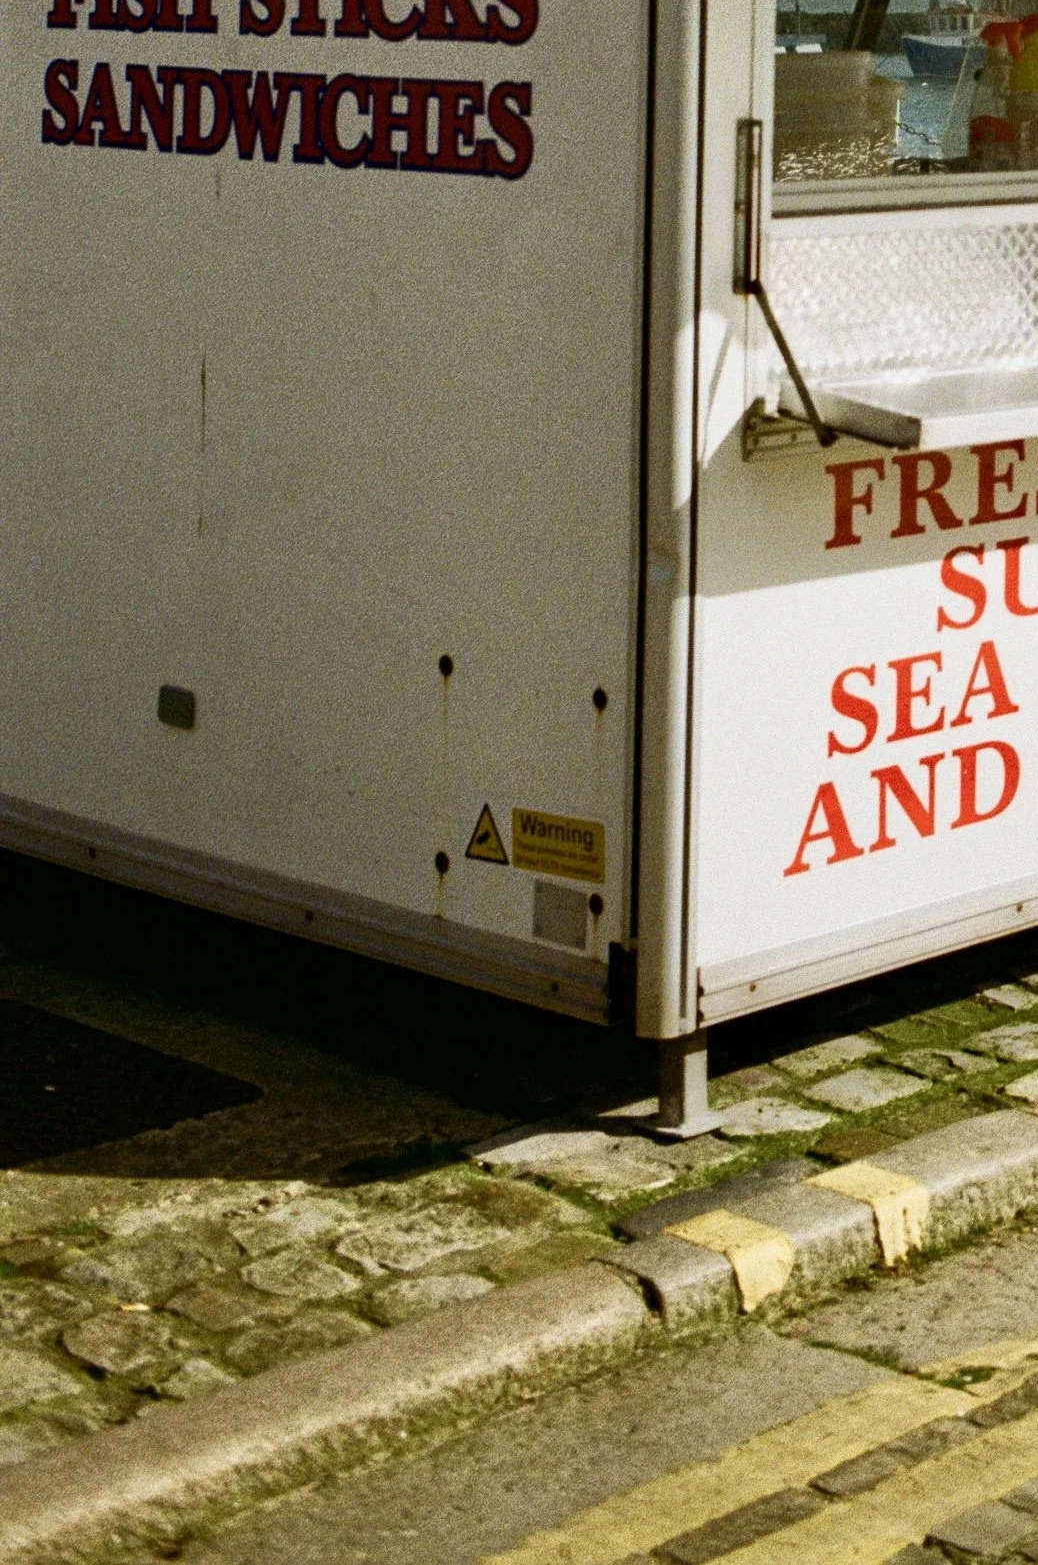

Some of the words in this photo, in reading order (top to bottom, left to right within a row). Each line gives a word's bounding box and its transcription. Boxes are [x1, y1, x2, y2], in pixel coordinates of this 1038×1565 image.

[42, 58, 534, 180] SANDWICHES
[826, 640, 1019, 758] SEA
[519, 813, 595, 852] Warning
[783, 741, 1020, 878] AND
